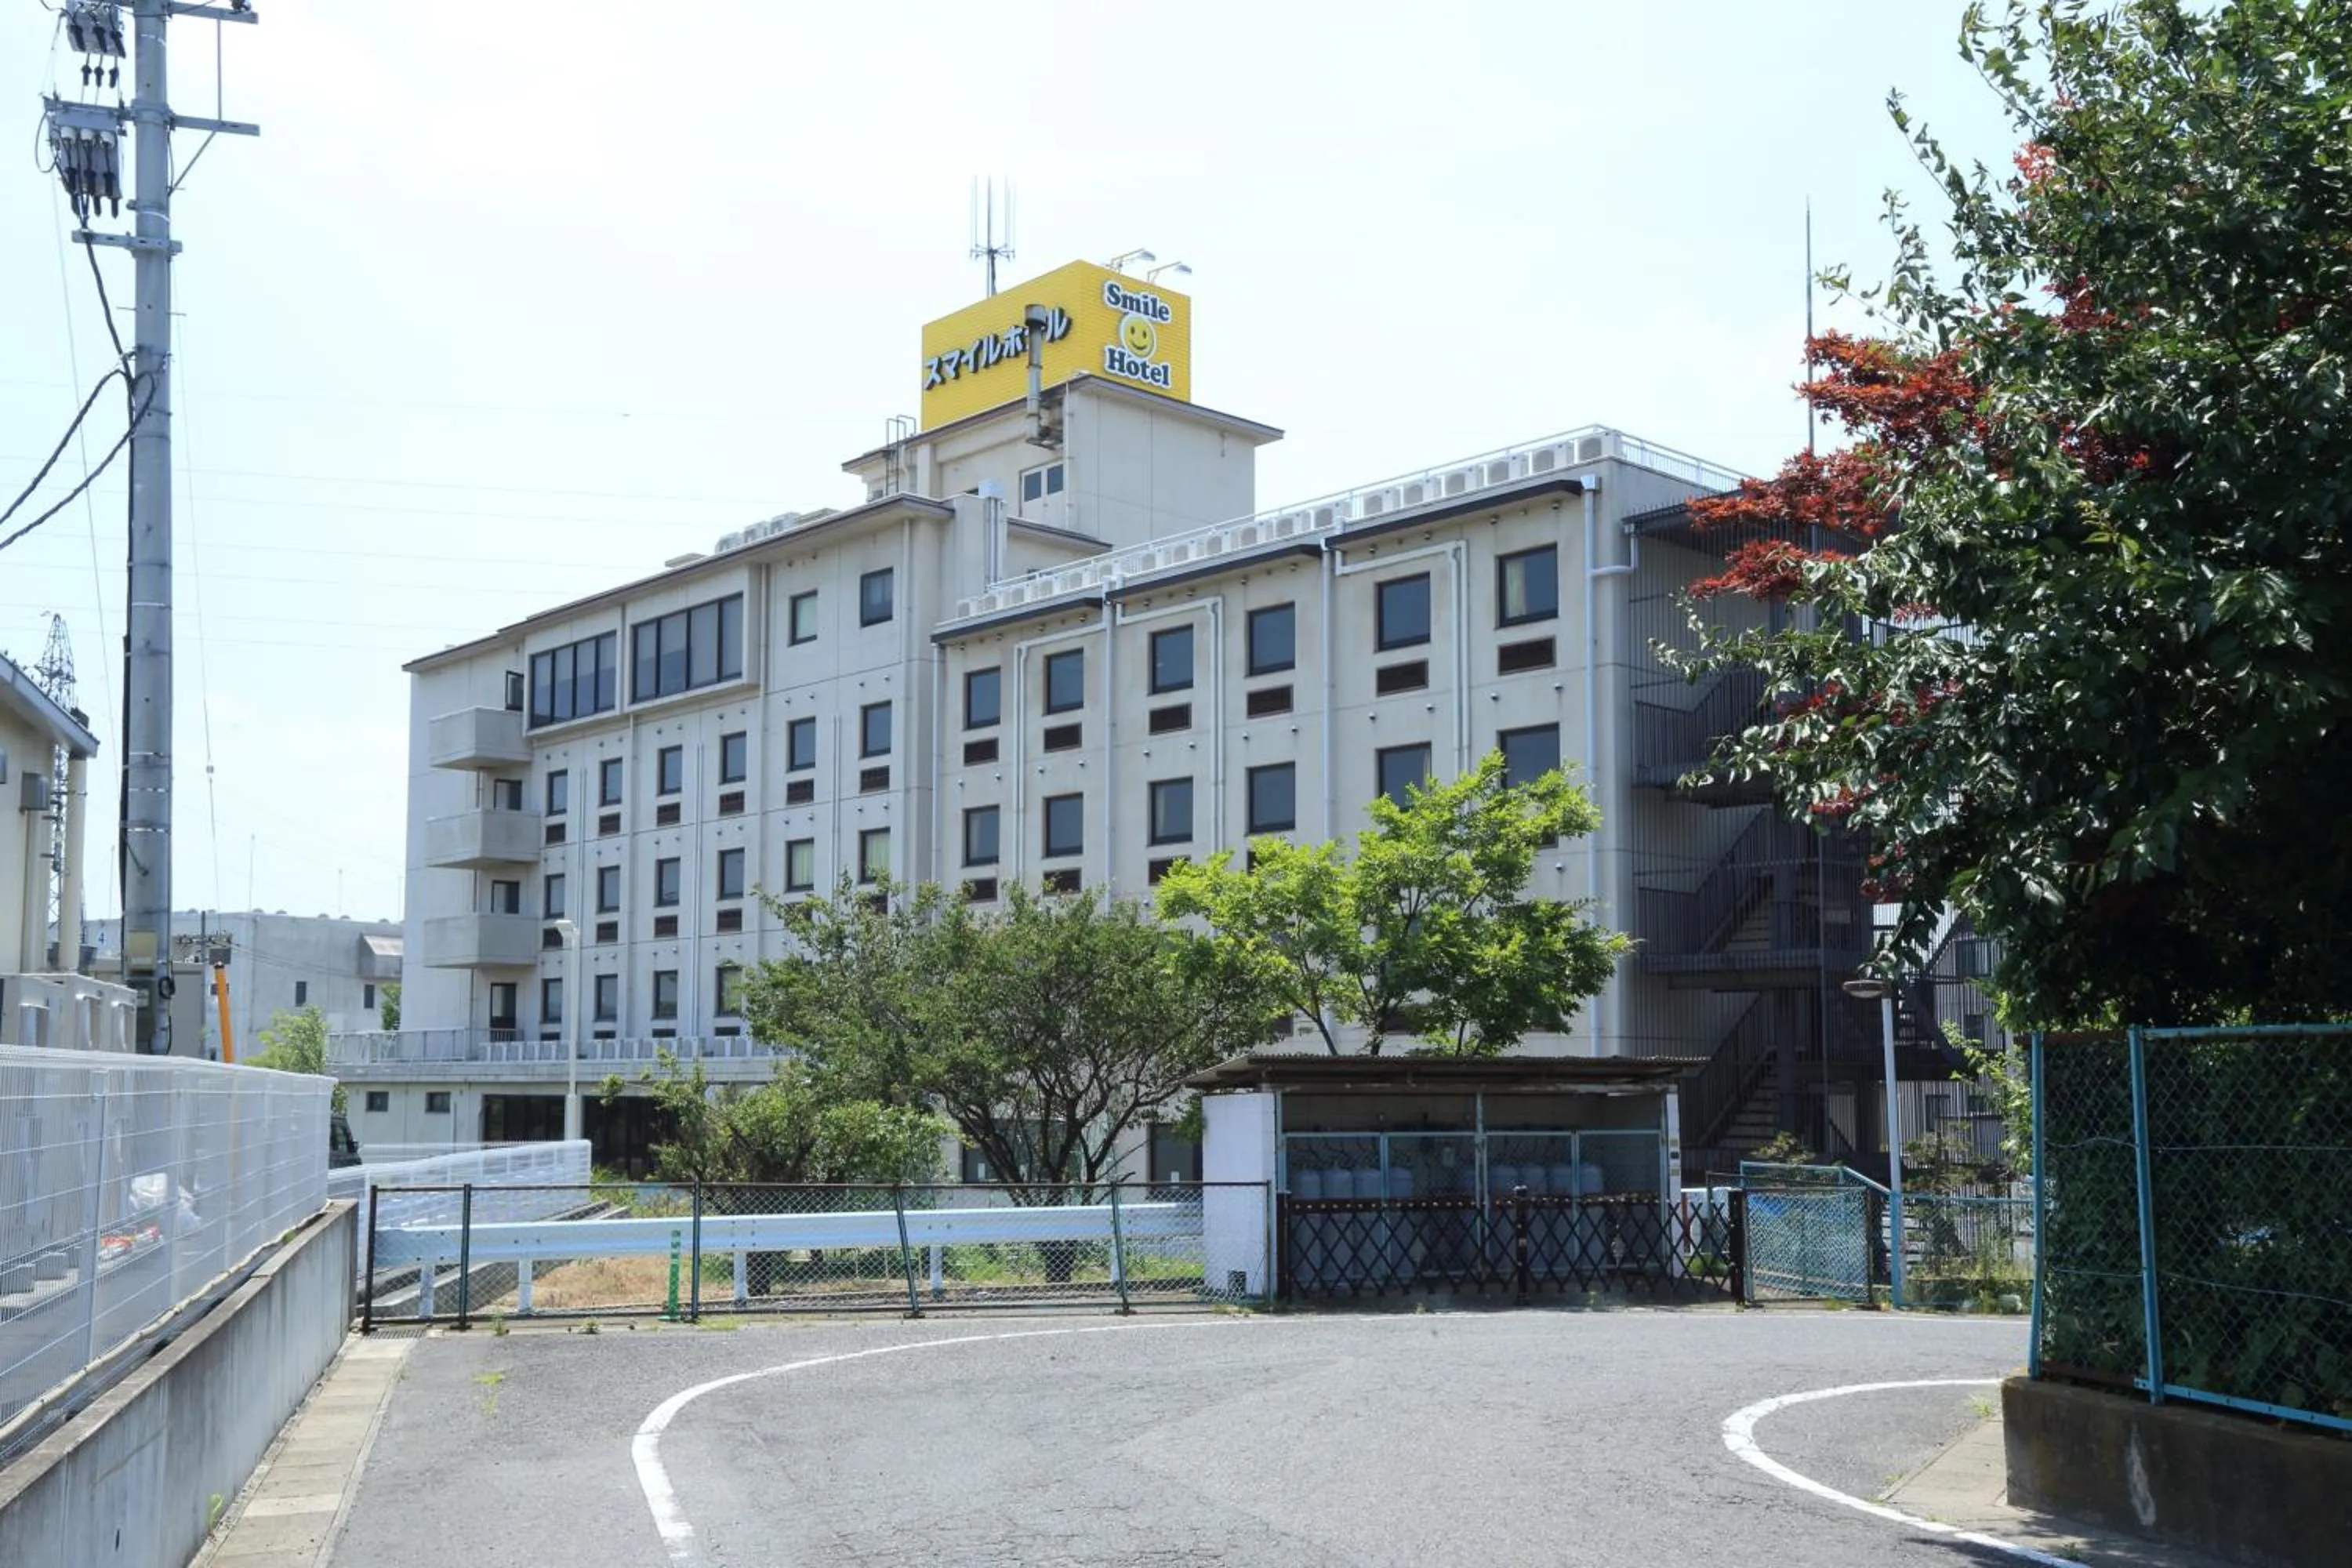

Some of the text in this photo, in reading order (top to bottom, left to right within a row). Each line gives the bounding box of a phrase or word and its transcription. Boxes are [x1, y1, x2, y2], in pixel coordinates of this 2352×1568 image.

[1105, 282, 1170, 321] Smile
[924, 307, 1072, 390] スマイルホル
[1106, 347, 1170, 387] Hotel
